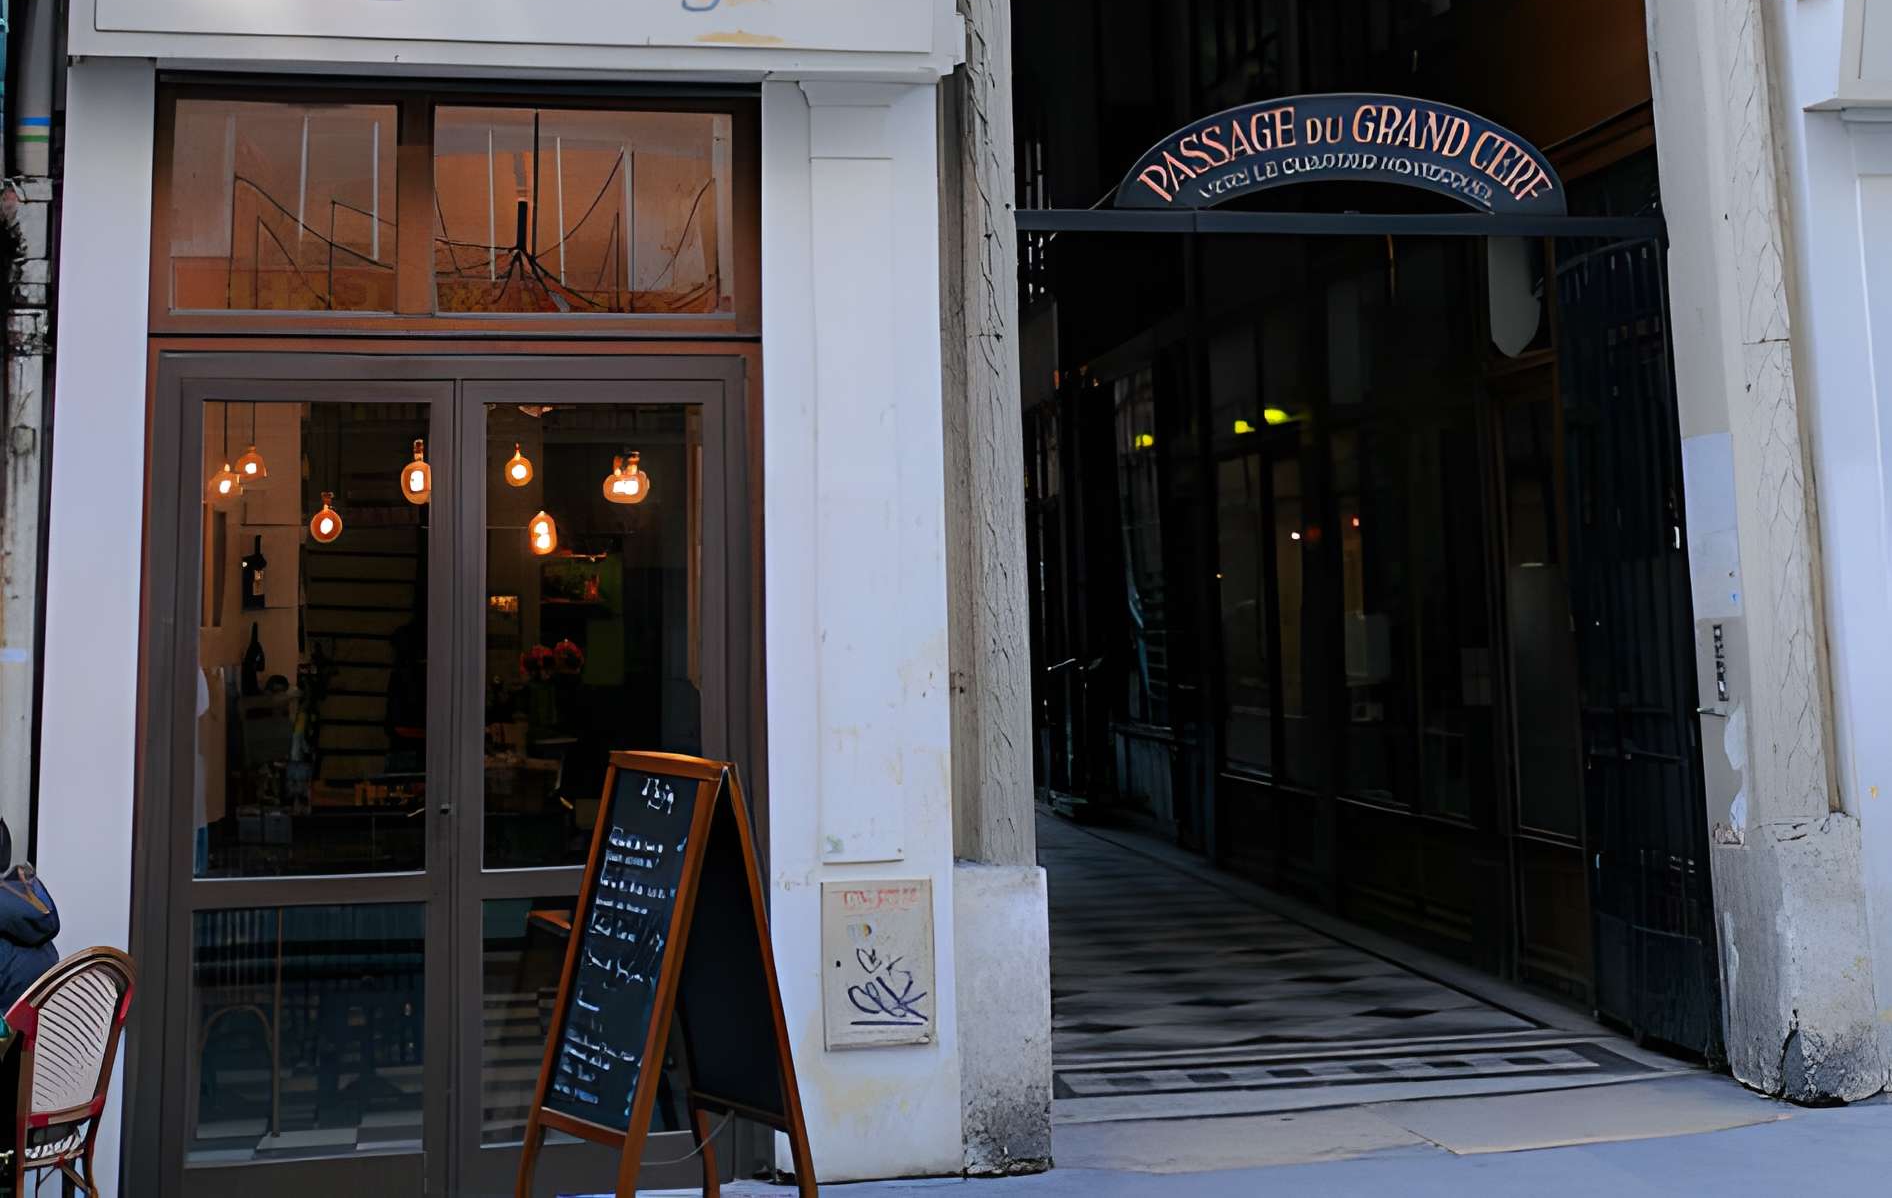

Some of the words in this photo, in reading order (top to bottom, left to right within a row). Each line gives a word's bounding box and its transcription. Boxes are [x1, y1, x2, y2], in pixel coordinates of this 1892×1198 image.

[1136, 106, 1297, 202] PASSAGE
[1305, 116, 1343, 145] DU
[1351, 104, 1471, 158] GRAND
[1469, 130, 1553, 201] CERF
